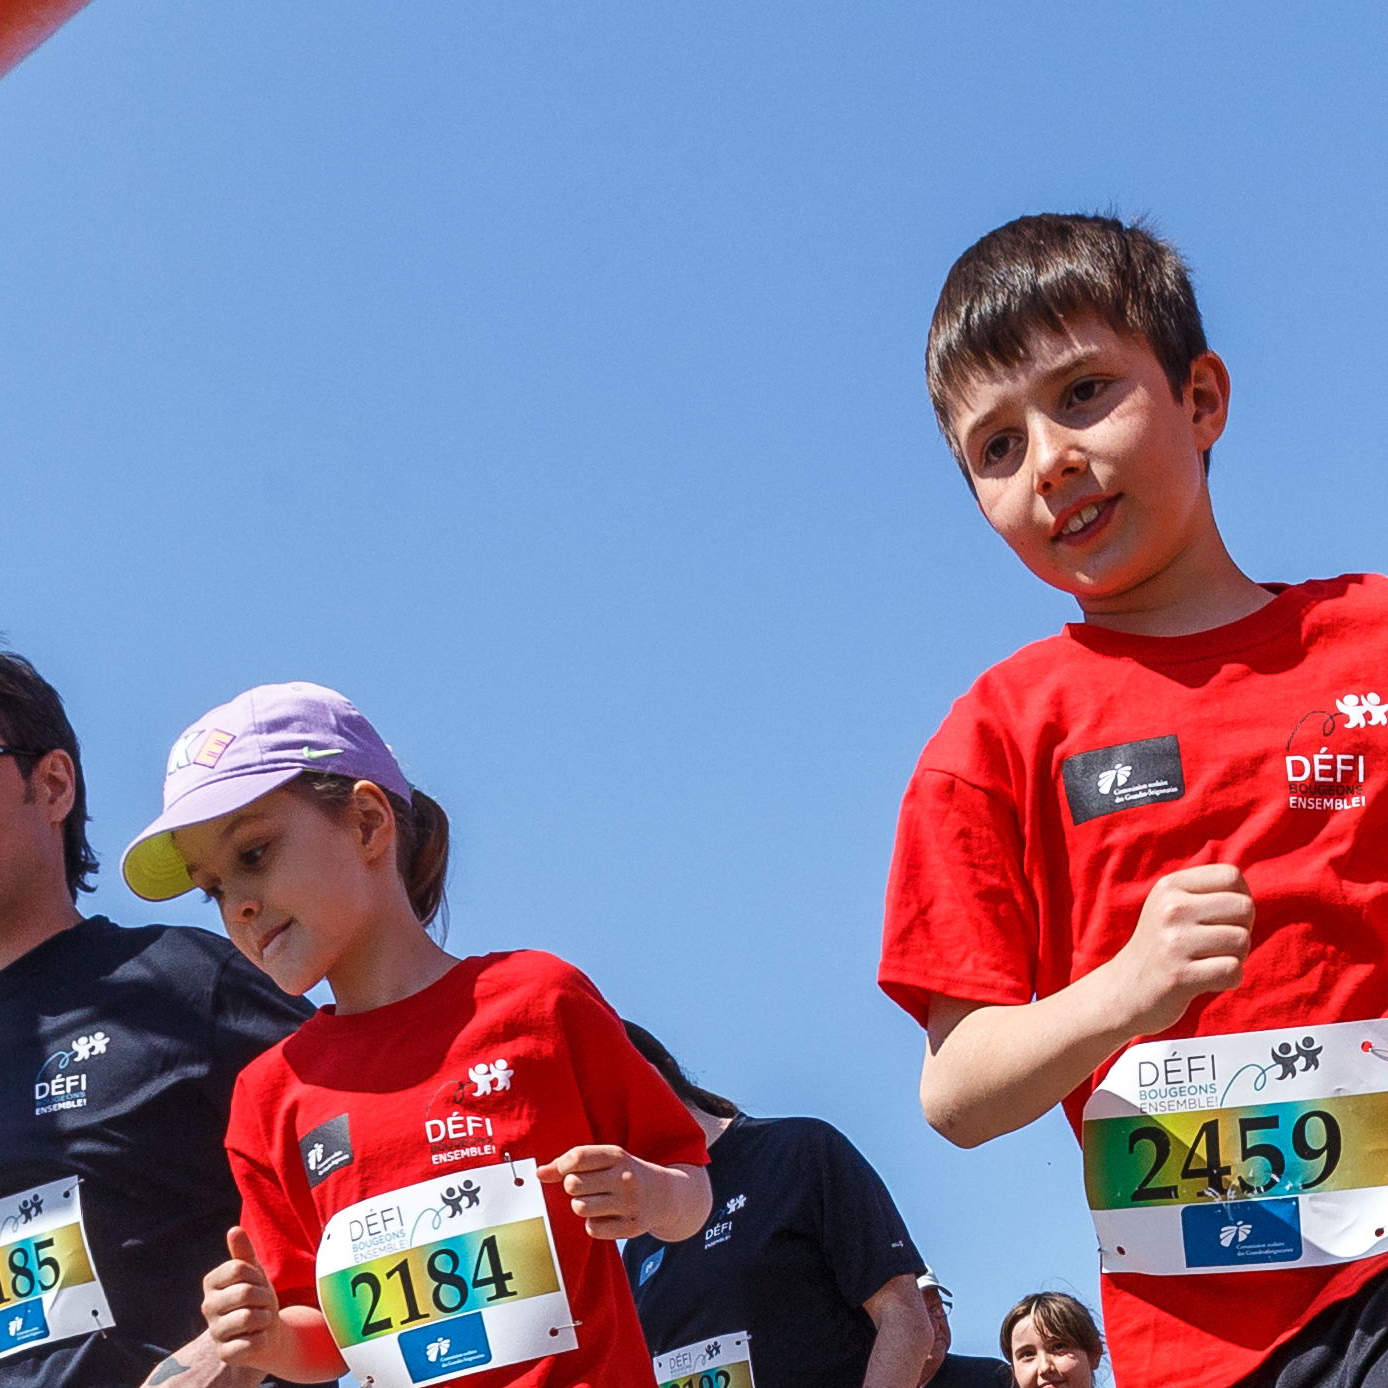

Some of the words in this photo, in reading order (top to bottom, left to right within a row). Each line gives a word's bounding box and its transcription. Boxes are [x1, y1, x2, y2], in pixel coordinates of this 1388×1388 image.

[1285, 747, 1364, 783] DÉFI
[1289, 783, 1364, 796] BOUGEONS
[1289, 796, 1366, 811] ENSEMBLE!
[1139, 1051, 1216, 1088] DÉFI
[35, 1074, 87, 1100] DÉFI
[1139, 1083, 1217, 1101] BOUGEONS
[35, 1098, 87, 1116] ENSEMBLE!
[1139, 1096, 1219, 1115] ENSEMBLE!
[425, 1111, 493, 1143] DÉFI
[432, 1145, 496, 1165] ENSEMBLE!
[1128, 1110, 1342, 1202] 2459
[349, 1205, 404, 1242] DÉFI
[705, 1221, 732, 1241] DÉFI
[352, 1229, 406, 1253] BOUGEONS
[354, 1239, 409, 1264] ENSEMBLE!
[350, 1235, 518, 1337] 2184
[669, 1352, 693, 1370] DÉFI
